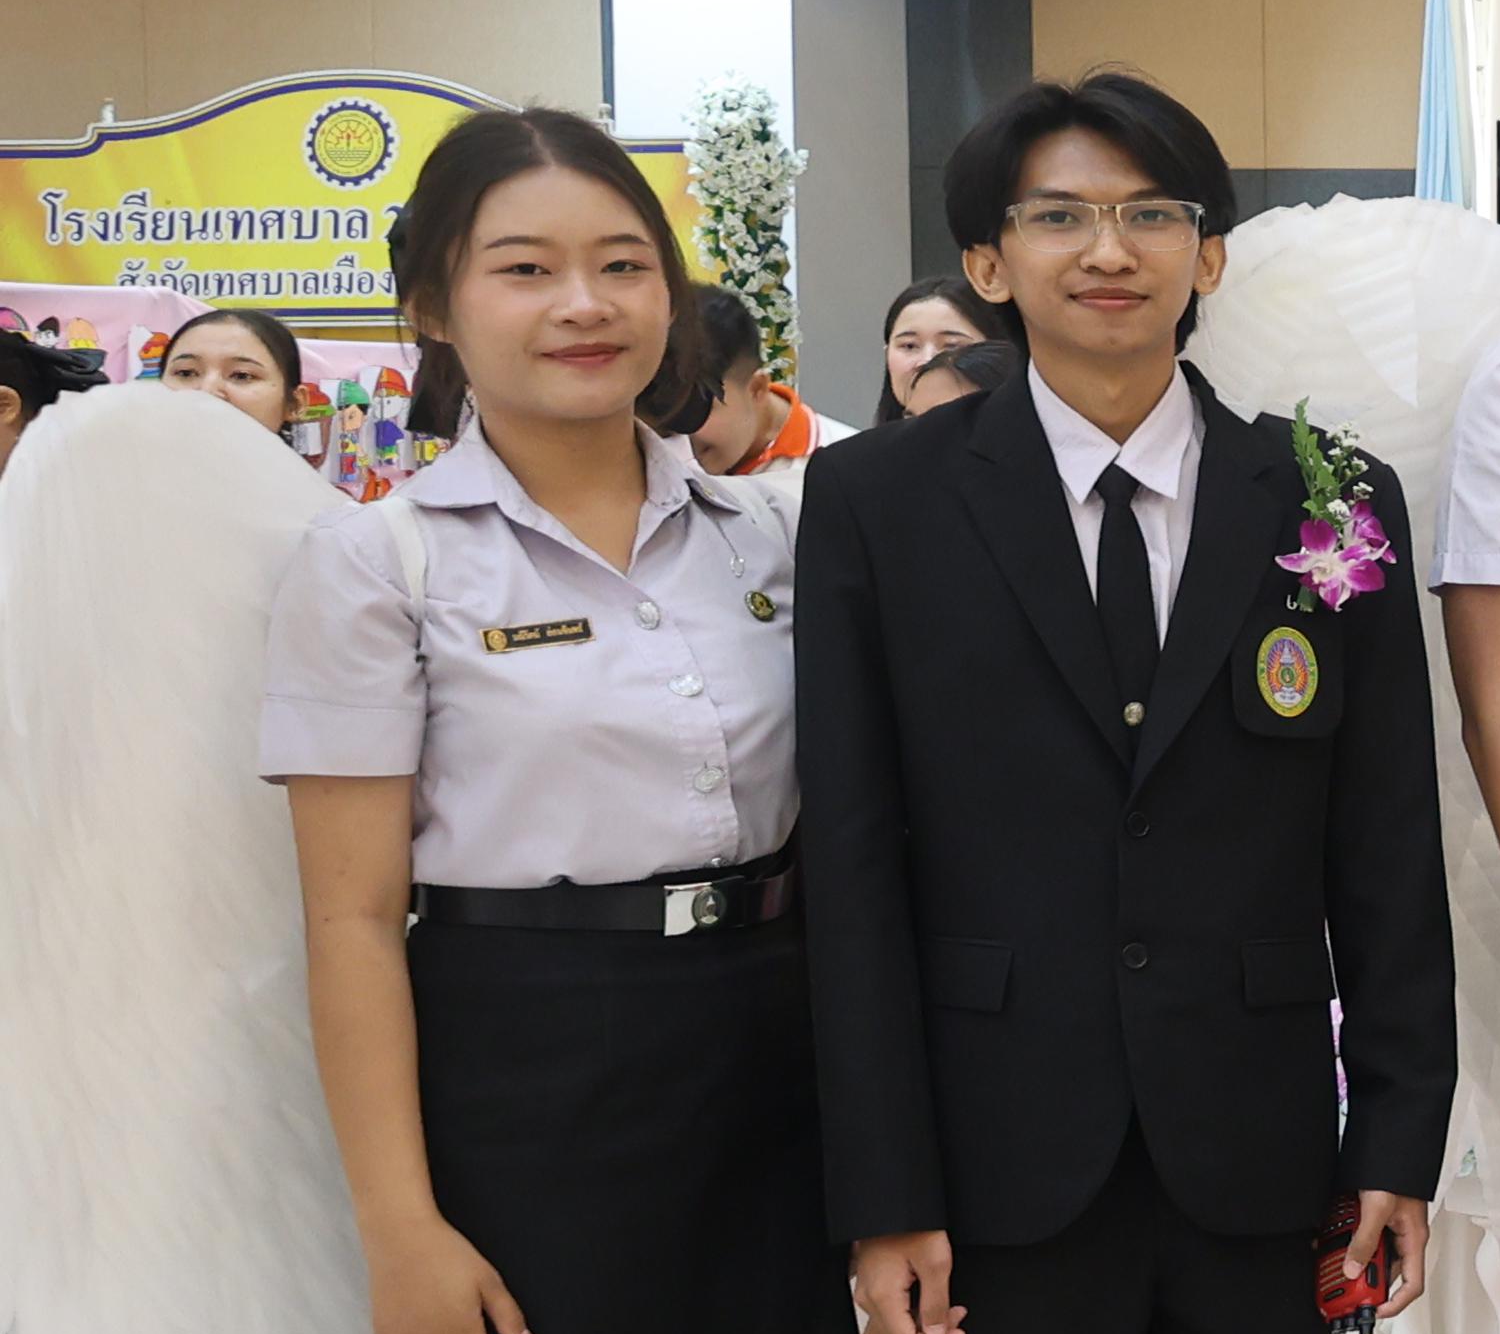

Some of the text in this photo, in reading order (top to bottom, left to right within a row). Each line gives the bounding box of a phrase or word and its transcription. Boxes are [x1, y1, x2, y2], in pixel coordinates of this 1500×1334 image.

[42, 191, 369, 242] โรงเรียนเทศบาล
